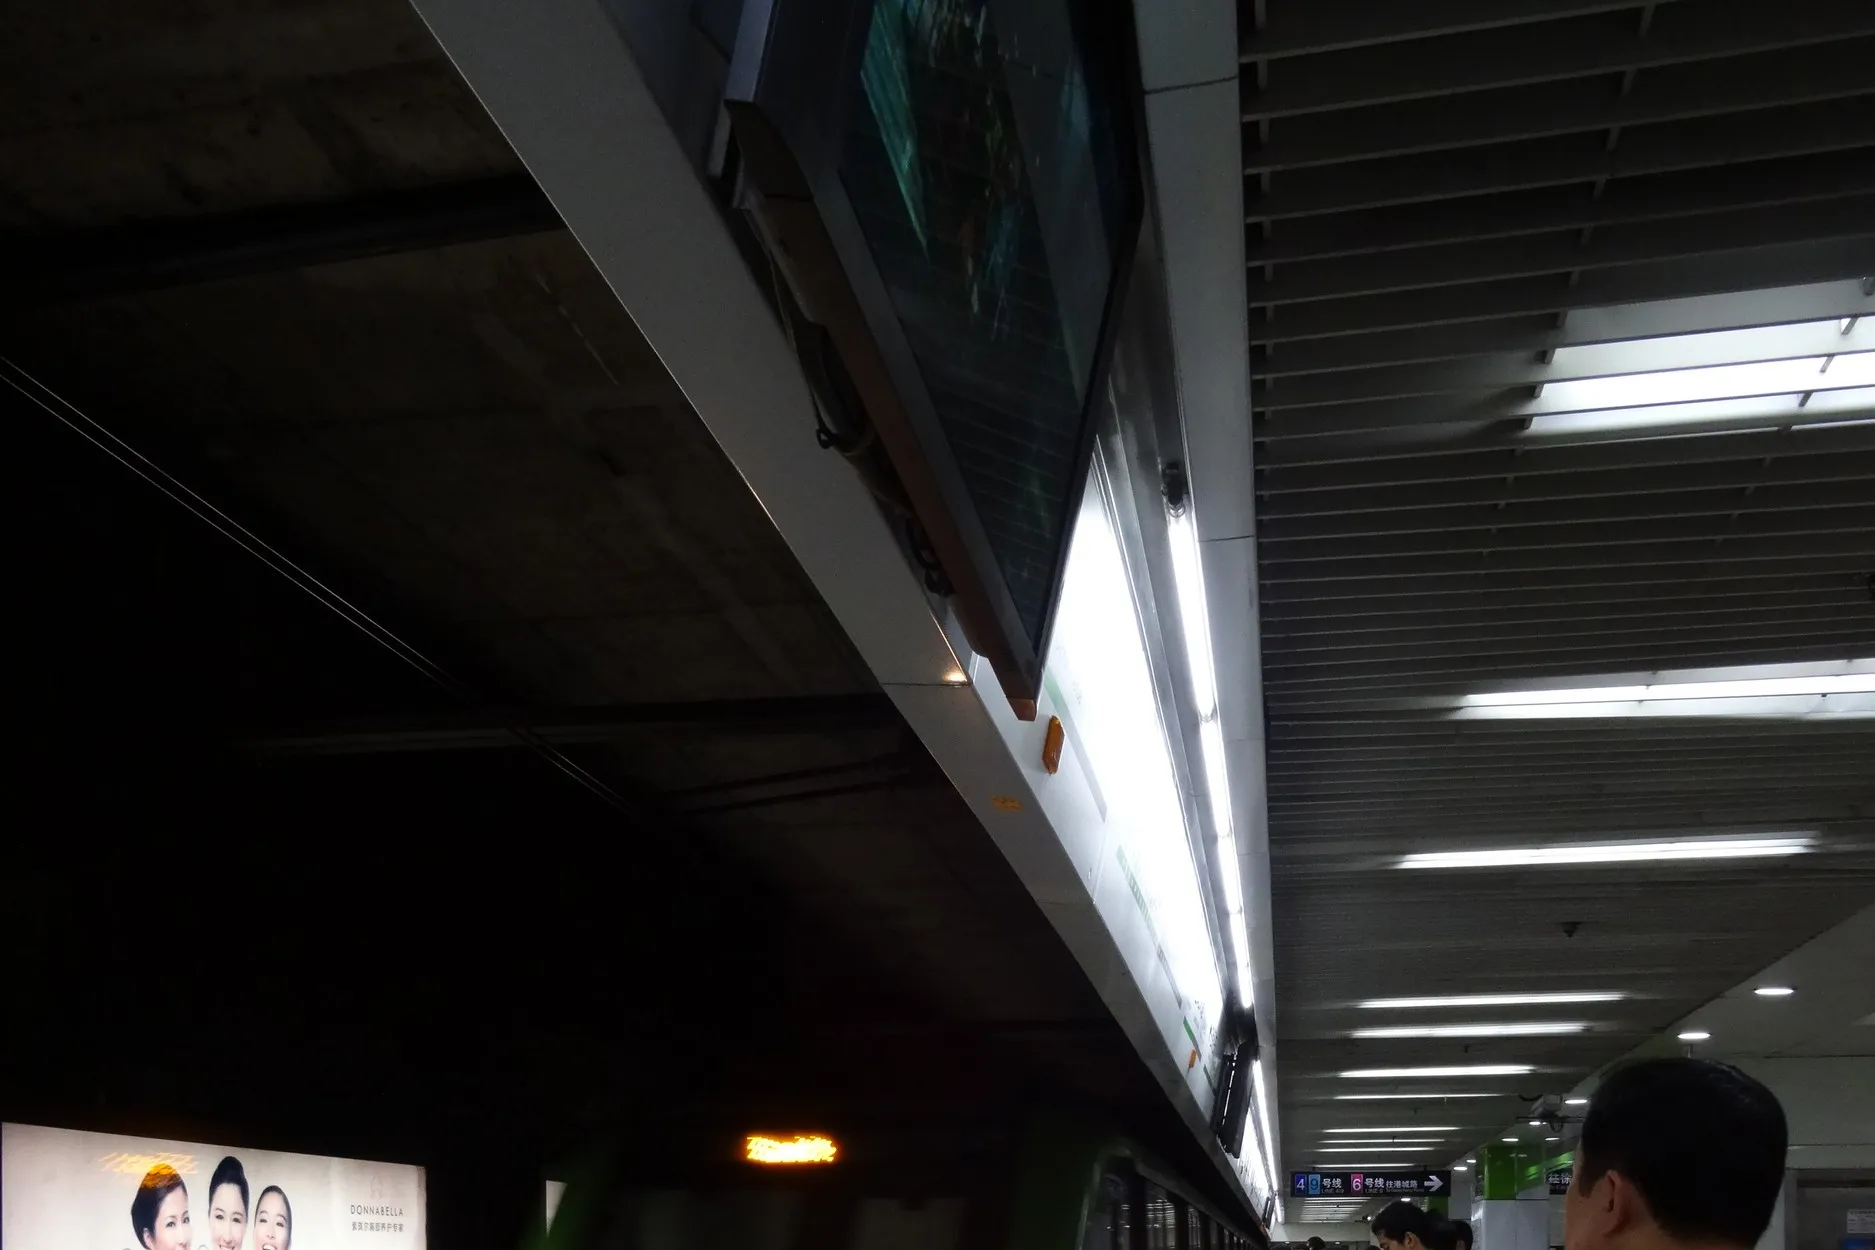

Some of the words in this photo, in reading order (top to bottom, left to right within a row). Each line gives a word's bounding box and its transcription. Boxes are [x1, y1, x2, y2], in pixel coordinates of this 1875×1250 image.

[1296, 1178, 1305, 1191] 4
[1310, 1178, 1319, 1191] 9
[1322, 1177, 1342, 1189] 号线
[1352, 1178, 1362, 1191] 6
[1364, 1177, 1385, 1189] 号线
[1385, 1179, 1418, 1189] 往港城路
[350, 1204, 404, 1217] DONNABELLA
